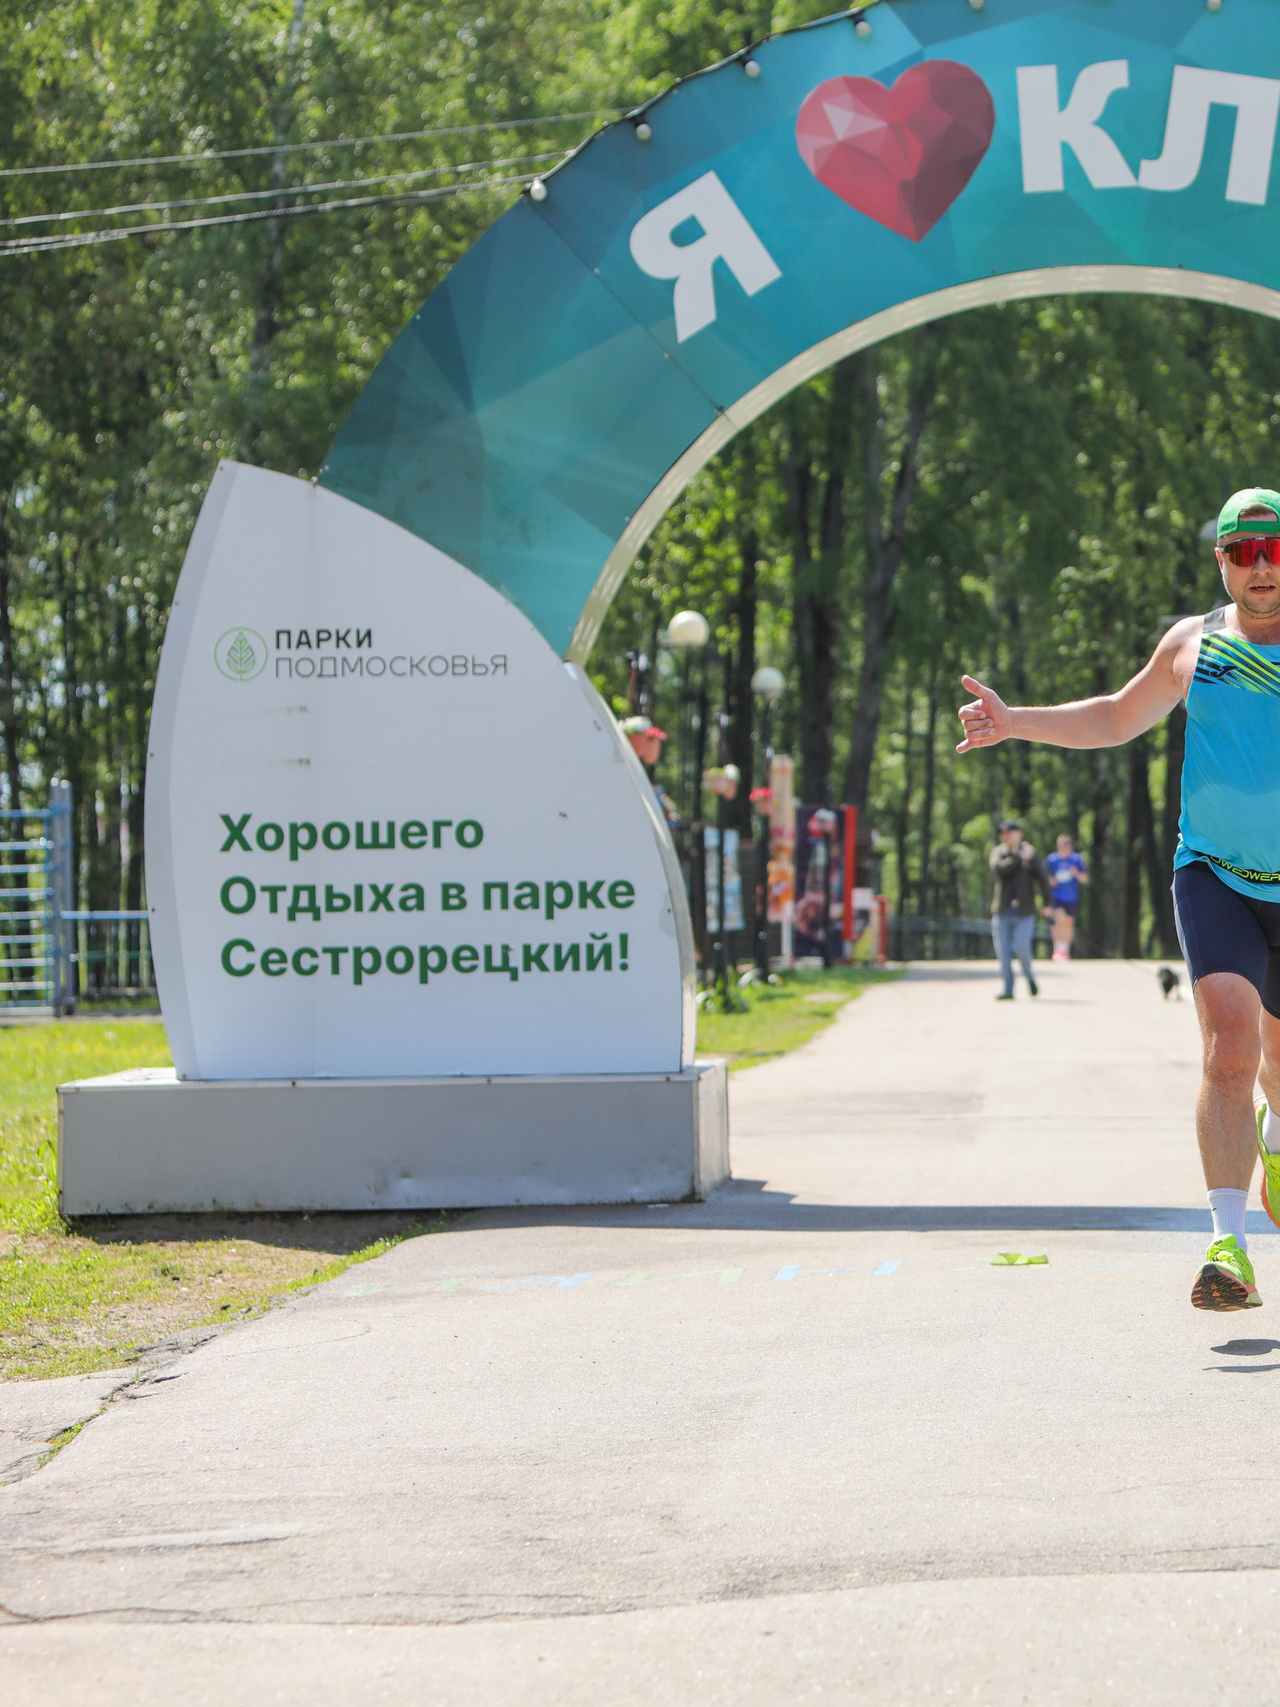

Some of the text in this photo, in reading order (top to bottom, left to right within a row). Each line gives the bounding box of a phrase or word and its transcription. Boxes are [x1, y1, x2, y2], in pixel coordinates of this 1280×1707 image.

[629, 171, 782, 343] Я
[275, 628, 372, 650] ПАРКИ
[275, 654, 508, 679] ПОДМОСКОВЬЯ
[219, 813, 484, 861] Хорошего
[219, 876, 636, 922] Отдыха в парке
[220, 932, 630, 986] Сестрорецкий!
